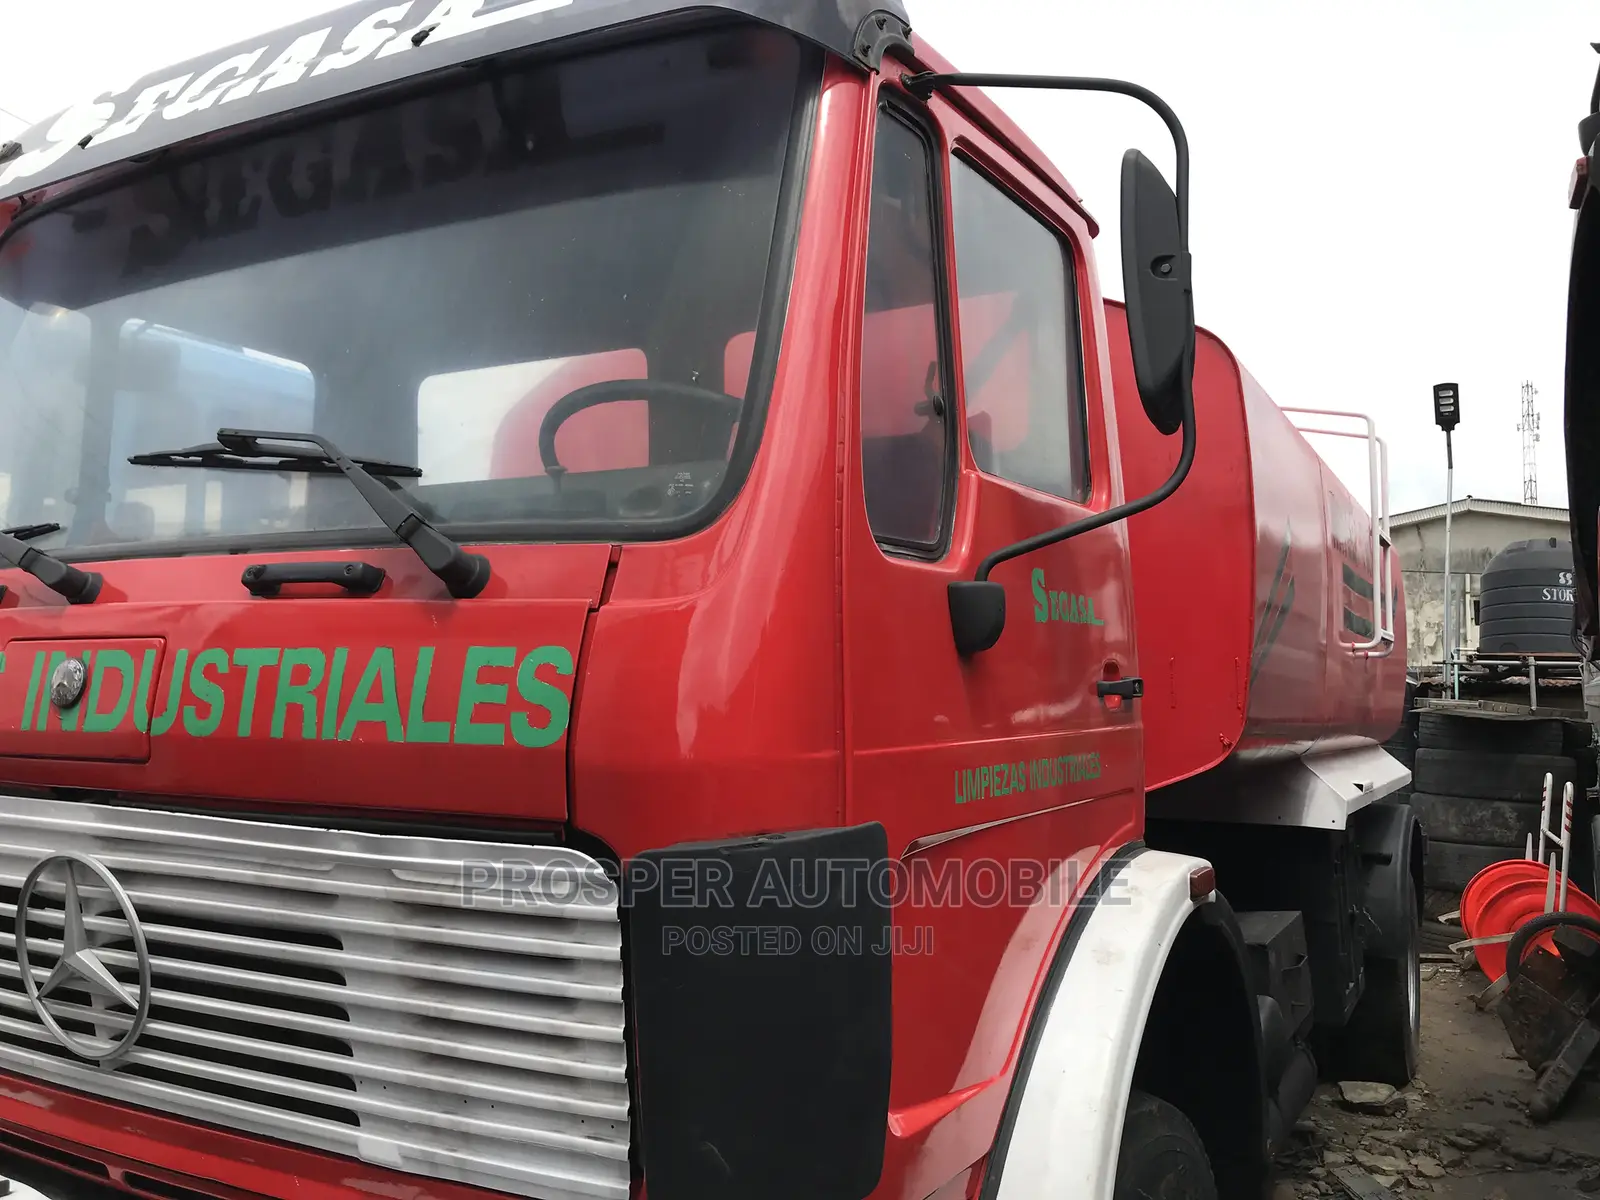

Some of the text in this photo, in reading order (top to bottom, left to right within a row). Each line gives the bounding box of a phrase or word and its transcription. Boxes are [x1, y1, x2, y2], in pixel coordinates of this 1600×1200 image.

[20, 645, 575, 748] INDUSTRIALES
[954, 752, 1100, 805] LIMPIEZAS INDUSTRIALES
